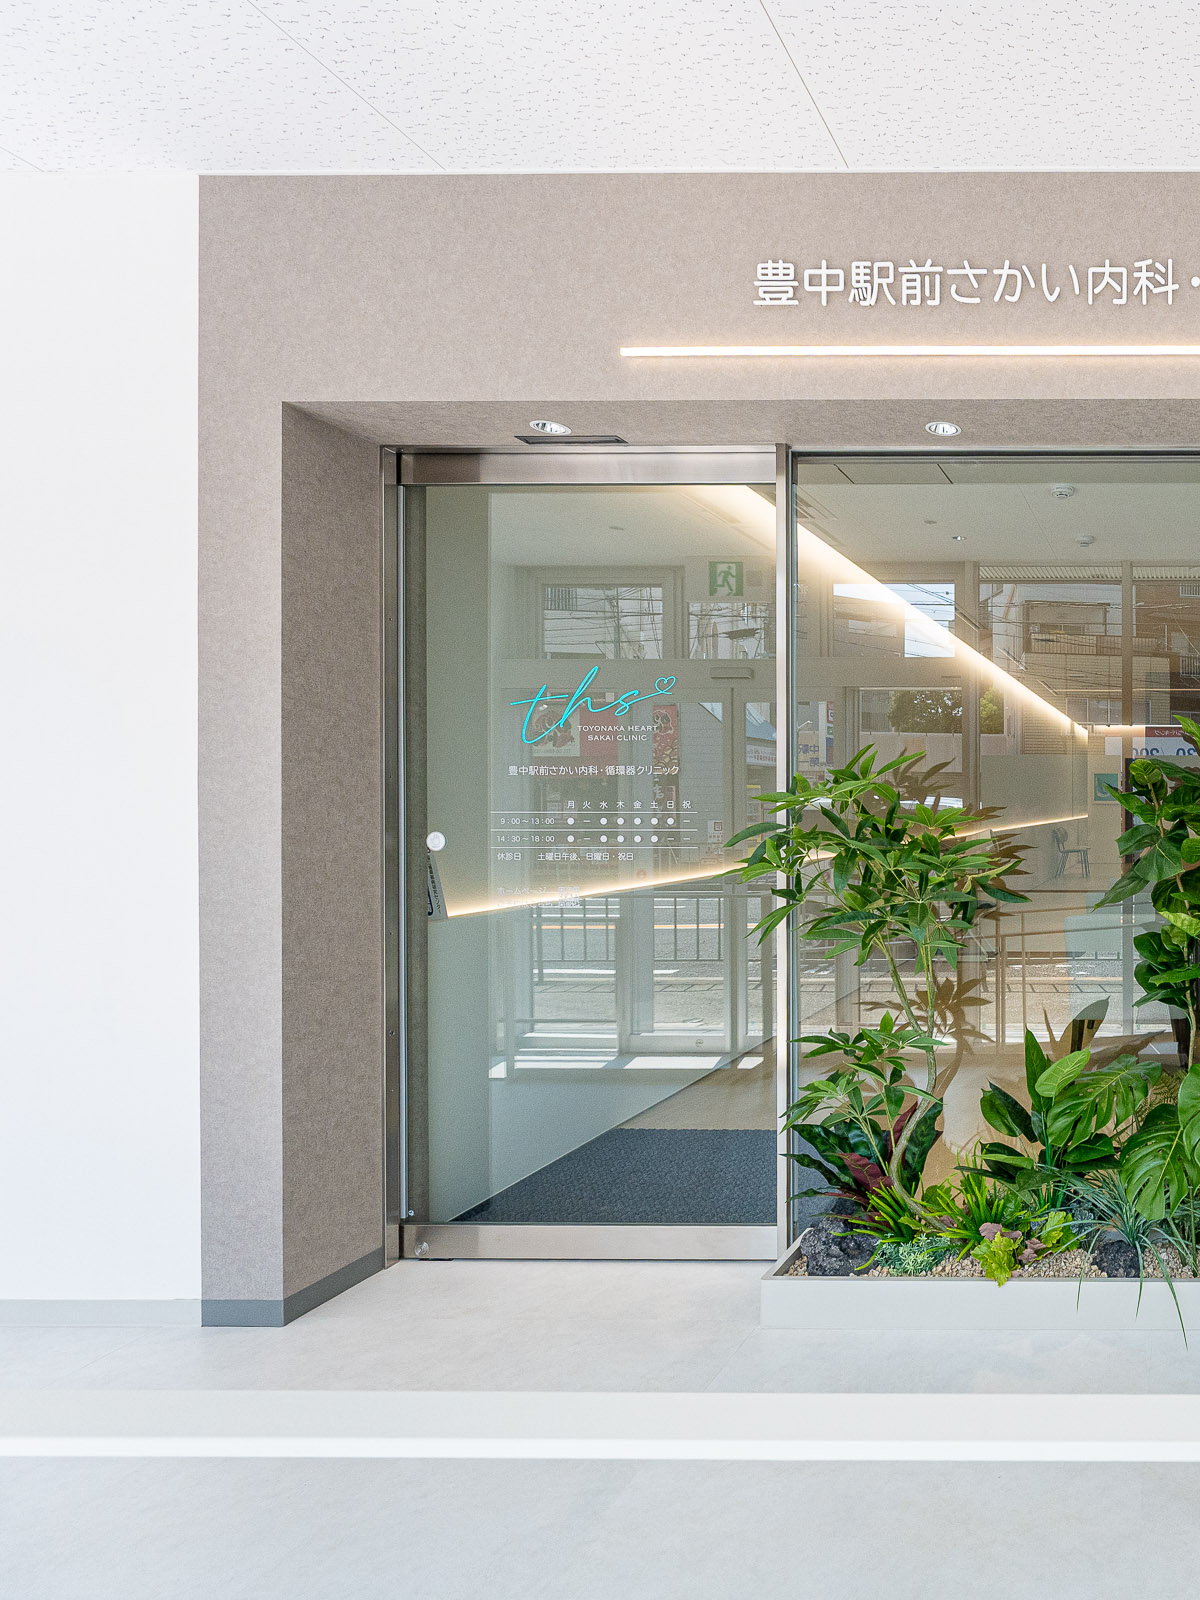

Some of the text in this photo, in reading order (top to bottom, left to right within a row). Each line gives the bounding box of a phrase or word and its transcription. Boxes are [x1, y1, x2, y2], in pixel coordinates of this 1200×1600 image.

[508, 765, 680, 776] 豊中駅前さかい内科・循環器クリニック
[567, 800, 691, 809] 月 火 水 木 金 土 日 祝
[497, 853, 522, 861] 休診日
